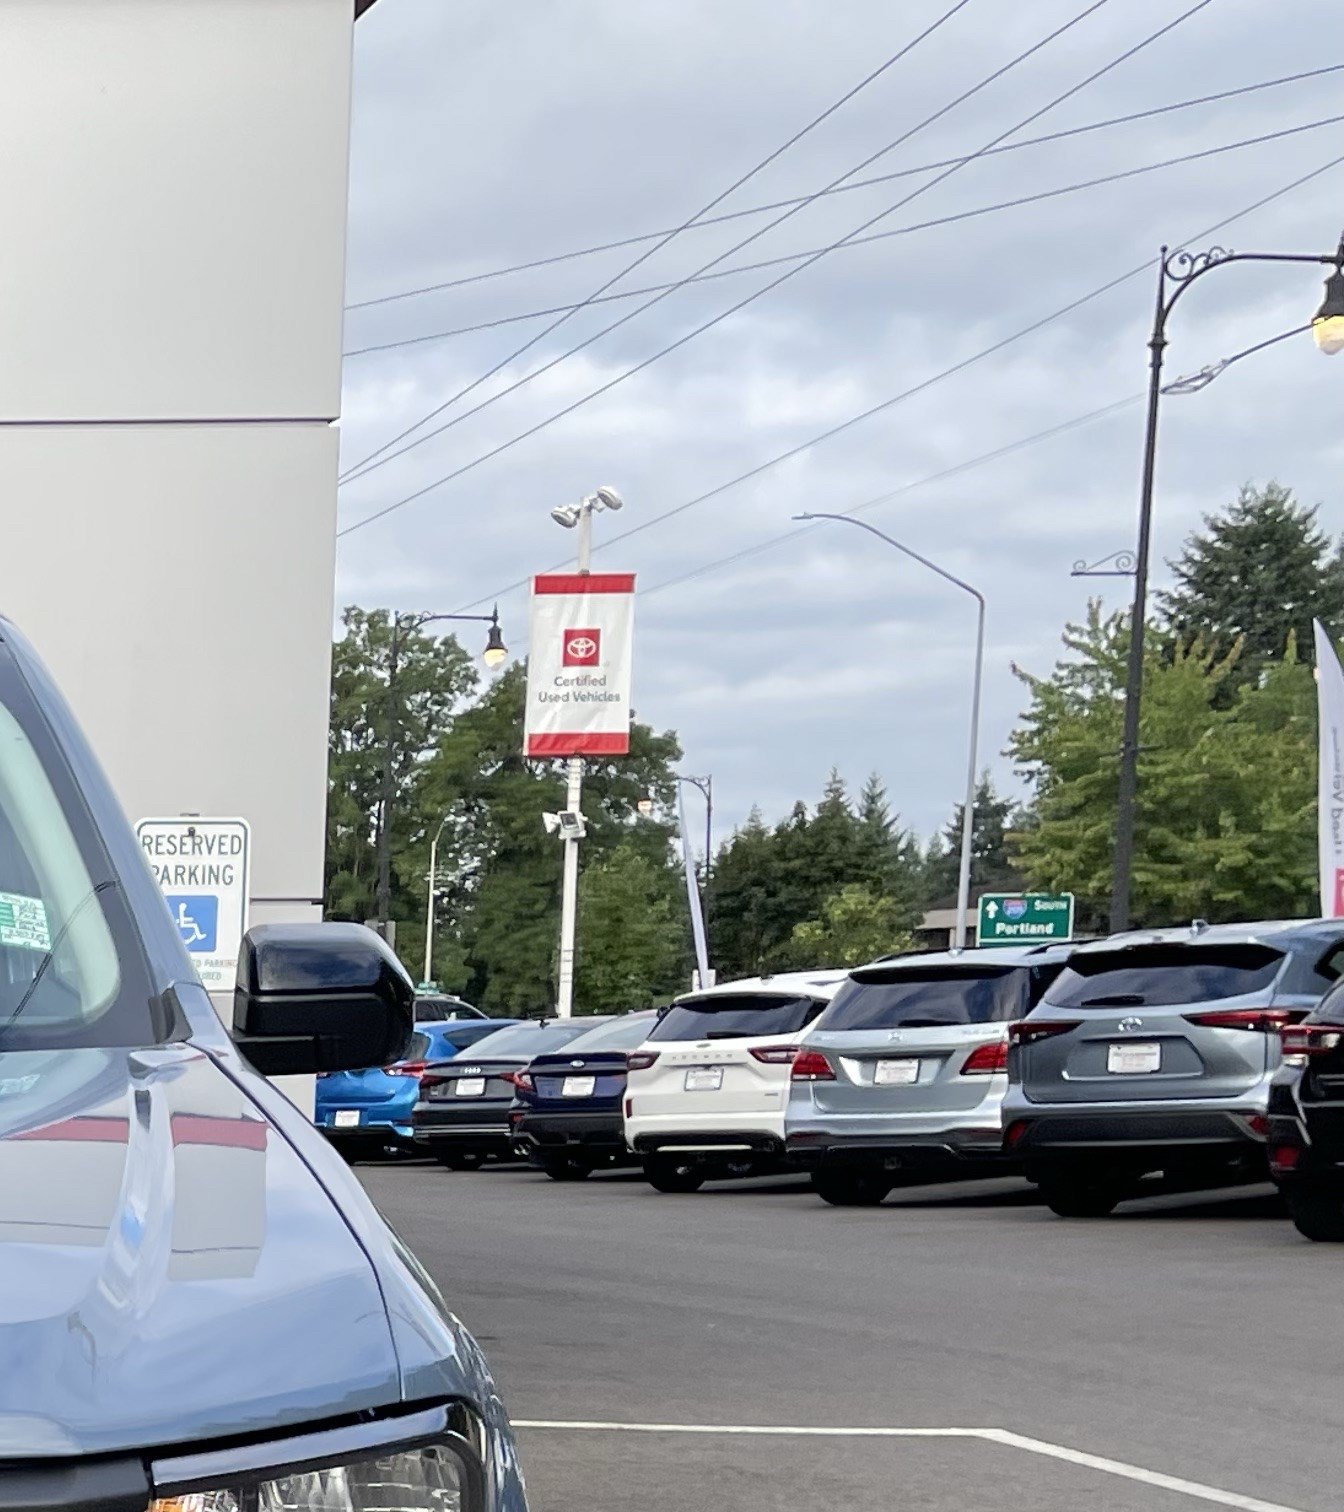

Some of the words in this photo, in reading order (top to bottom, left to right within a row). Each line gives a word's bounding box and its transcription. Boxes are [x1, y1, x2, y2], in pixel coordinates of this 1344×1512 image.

[554, 674, 606, 686] Certified
[538, 691, 569, 702] Used
[573, 691, 621, 702] Vehicles
[142, 834, 242, 855] RESERVED
[995, 922, 1054, 935] Portland
